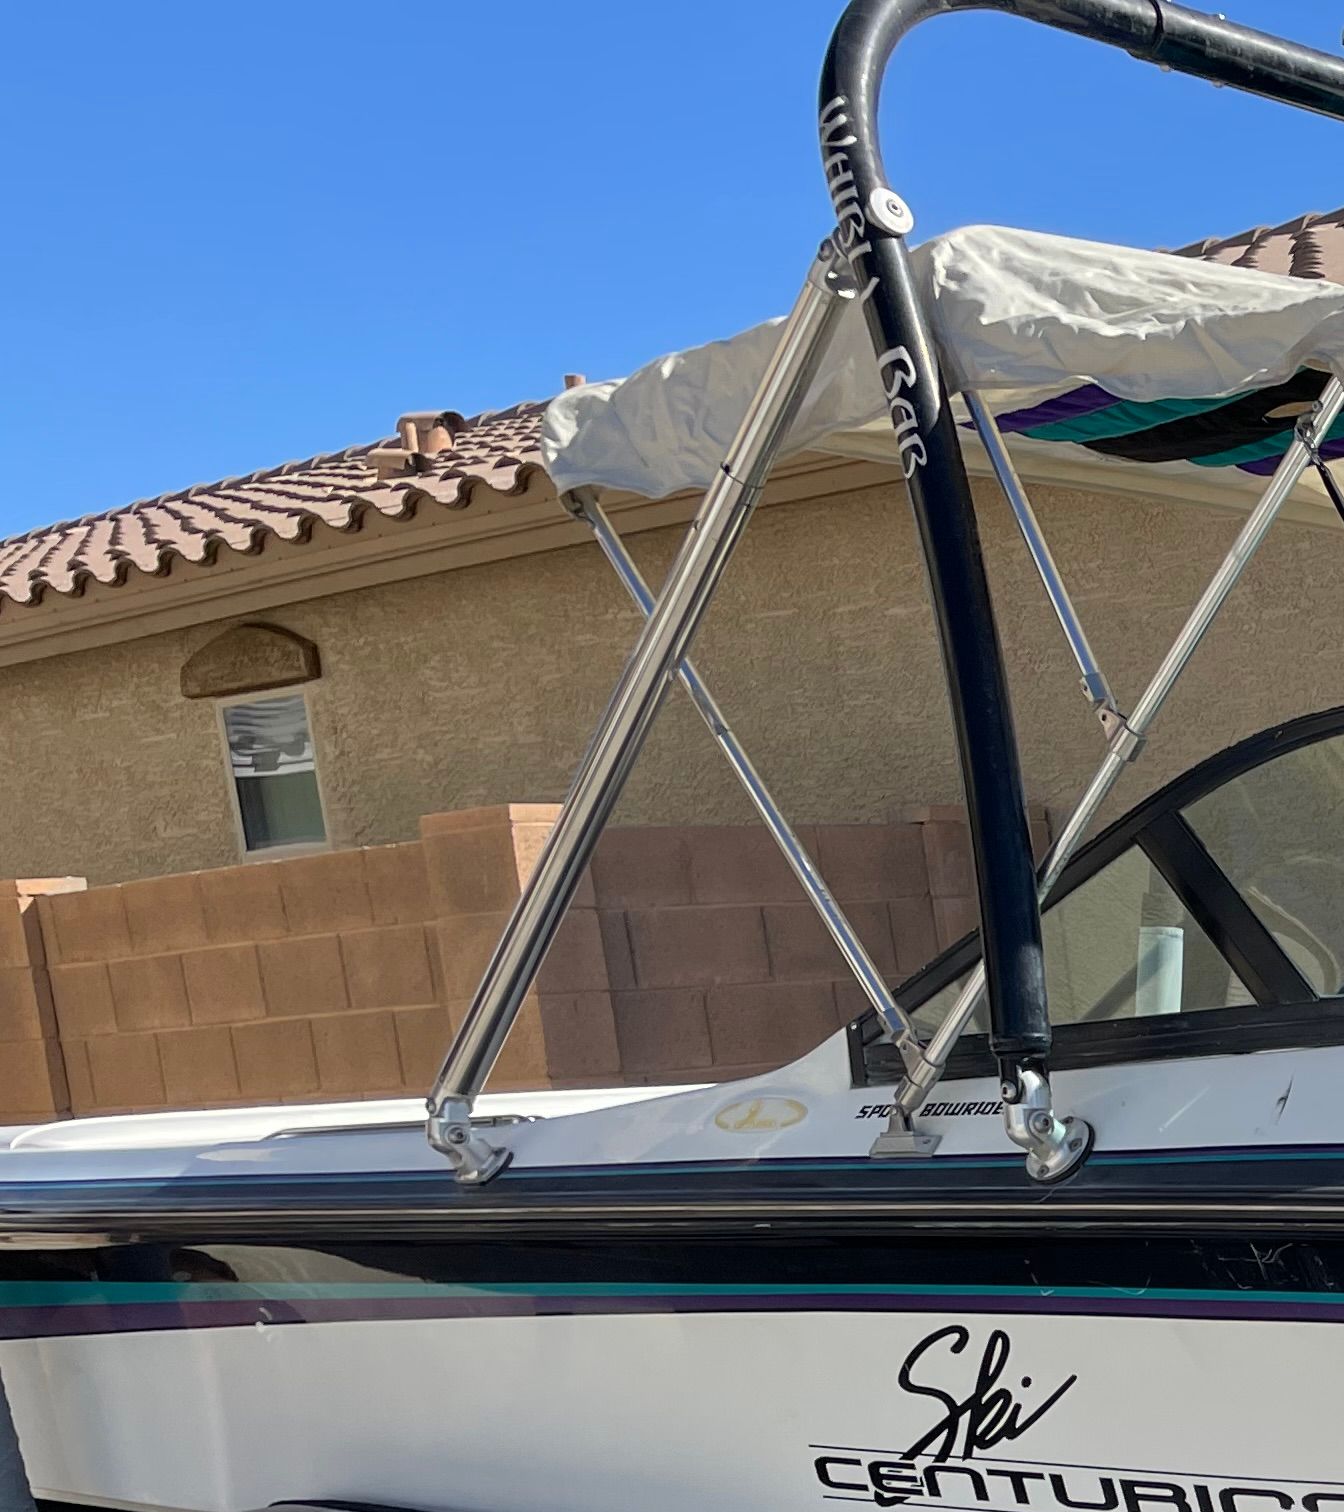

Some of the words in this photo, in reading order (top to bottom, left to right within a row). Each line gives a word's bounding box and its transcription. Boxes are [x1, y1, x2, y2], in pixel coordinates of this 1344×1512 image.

[878, 345, 927, 479] BAR
[855, 1104, 894, 1119] SPO
[919, 1101, 1004, 1117] BOWRIDE
[896, 1325, 1077, 1464] Ski
